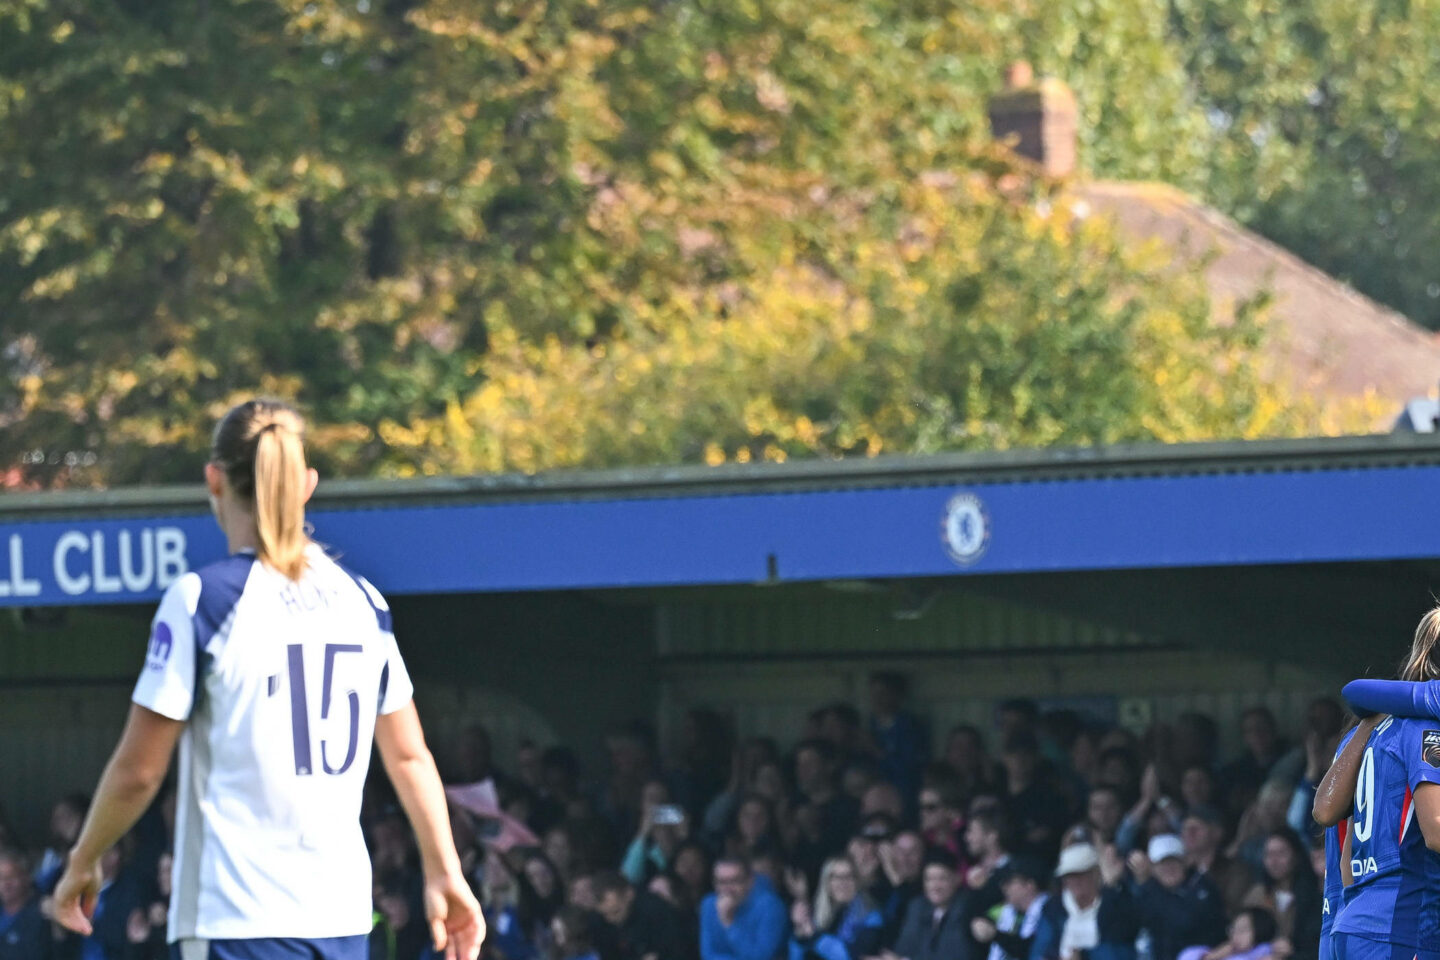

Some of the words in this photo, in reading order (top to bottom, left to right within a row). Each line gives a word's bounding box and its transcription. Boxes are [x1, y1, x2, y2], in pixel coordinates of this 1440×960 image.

[0, 535, 41, 598] L
[53, 527, 190, 596] CLUB
[268, 643, 363, 776] 15
